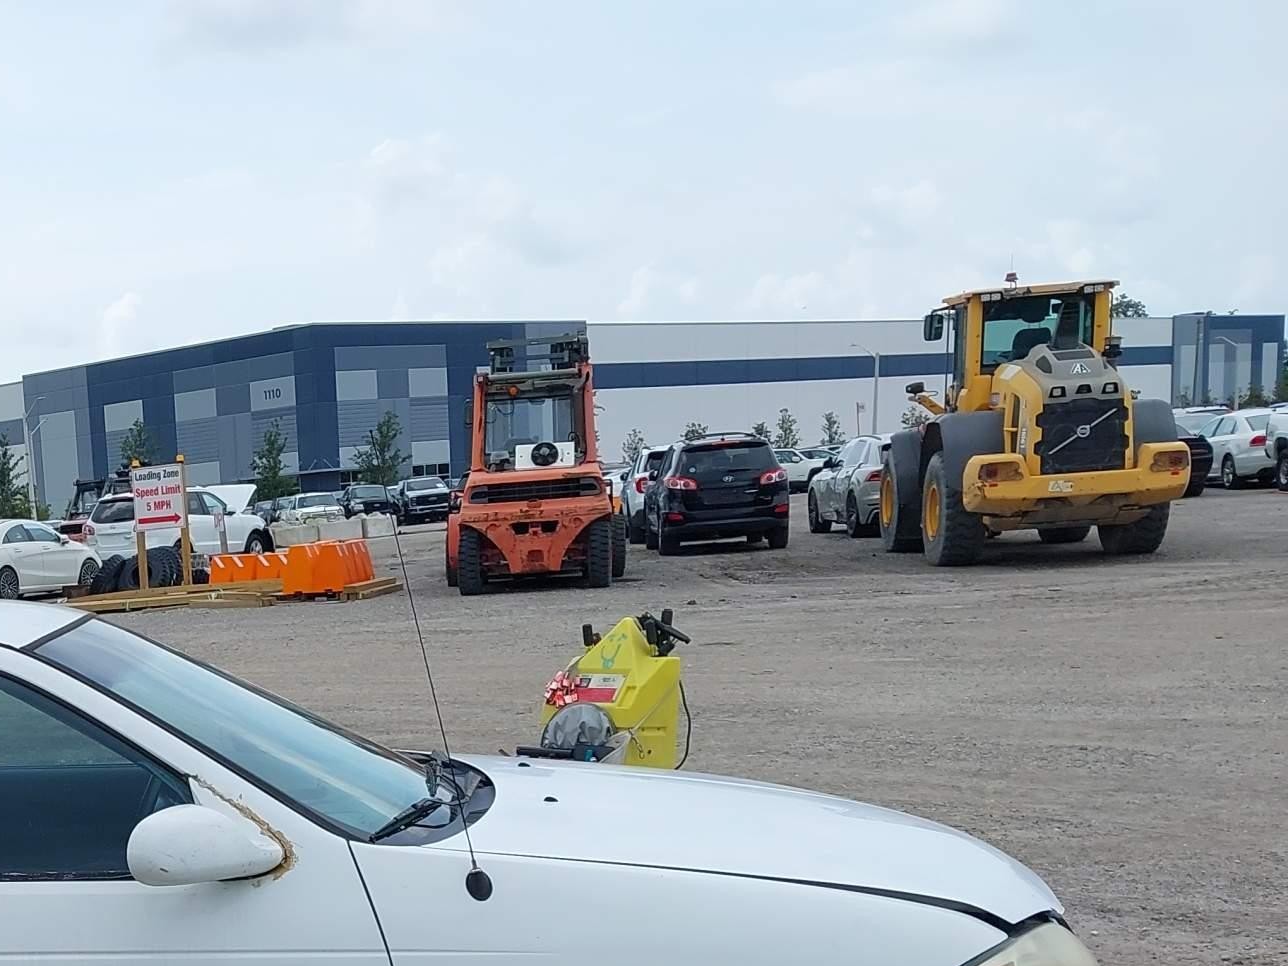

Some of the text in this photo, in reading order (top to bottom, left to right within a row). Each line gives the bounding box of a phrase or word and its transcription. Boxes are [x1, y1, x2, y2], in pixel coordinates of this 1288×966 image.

[264, 388, 281, 400] 1110
[134, 469, 179, 481] Loading Zone
[135, 484, 181, 499] Speed Limit
[146, 500, 172, 511] 5 MPH
